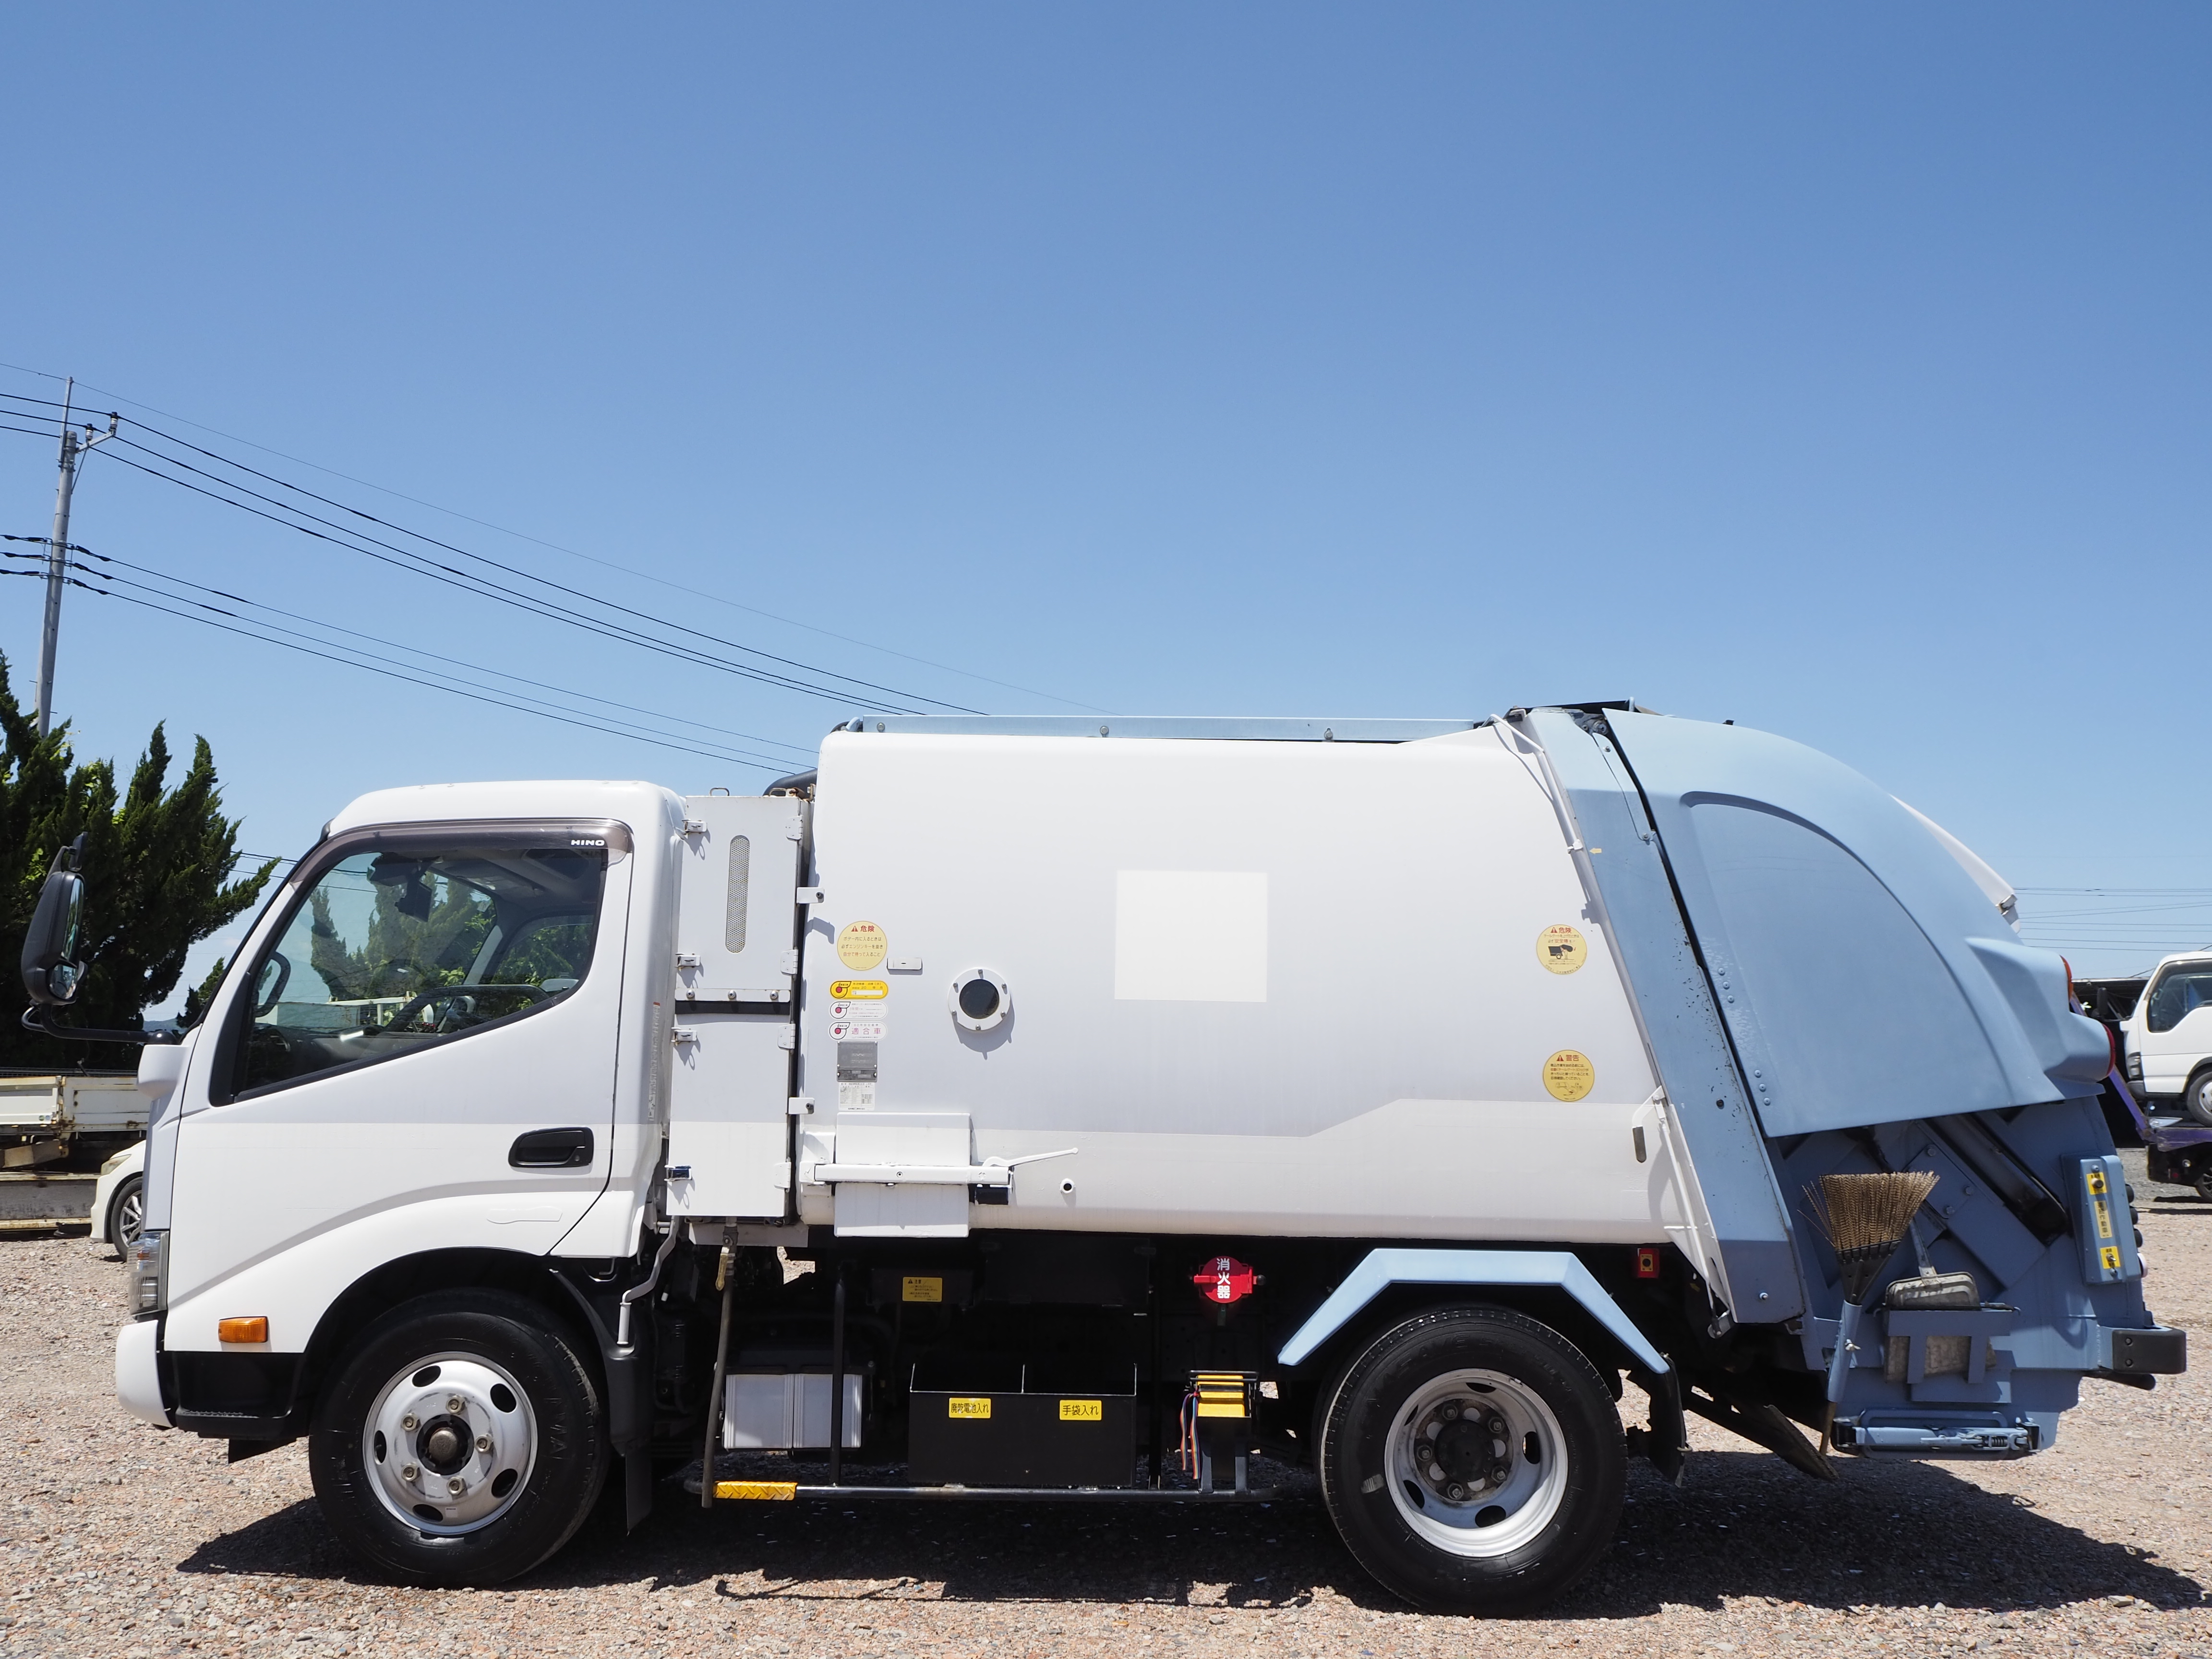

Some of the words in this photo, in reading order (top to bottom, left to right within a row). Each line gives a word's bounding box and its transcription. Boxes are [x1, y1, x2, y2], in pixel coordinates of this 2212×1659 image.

[1216, 1258, 1231, 1298] 消火器
[950, 1403, 989, 1413] 廃乾電池入れ
[1062, 1405, 1099, 1416] 手袋入れ
